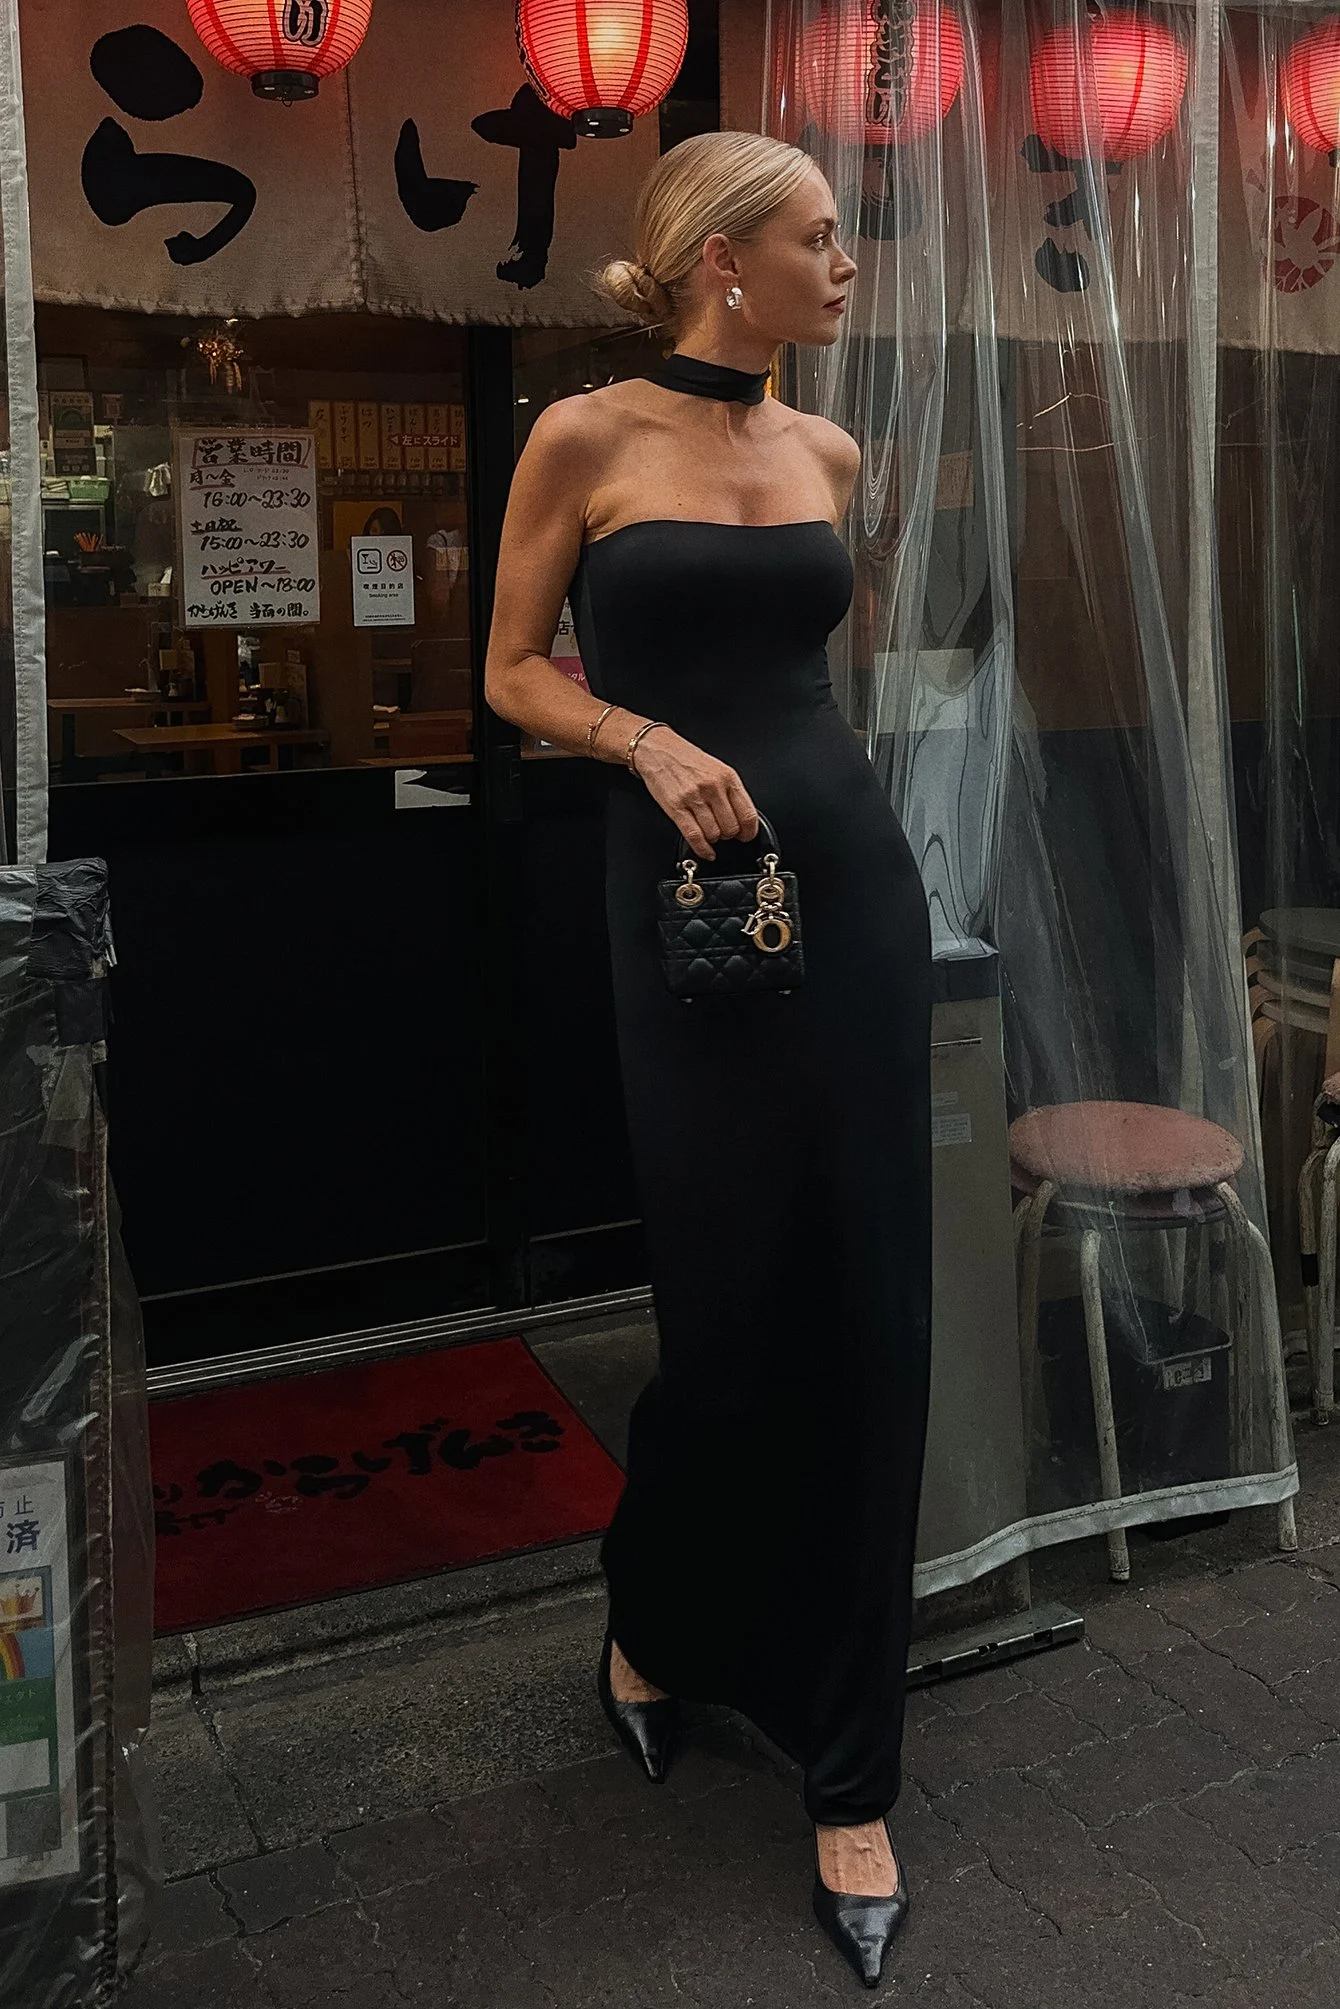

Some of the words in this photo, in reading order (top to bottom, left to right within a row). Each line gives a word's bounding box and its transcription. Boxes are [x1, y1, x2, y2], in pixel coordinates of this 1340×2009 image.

[401, 434, 458, 446] 左にスライド
[198, 439, 302, 465] 営業時間
[190, 517, 237, 533] 土日祝
[568, 672, 586, 682] タル
[6, 1518, 41, 1554] 済
